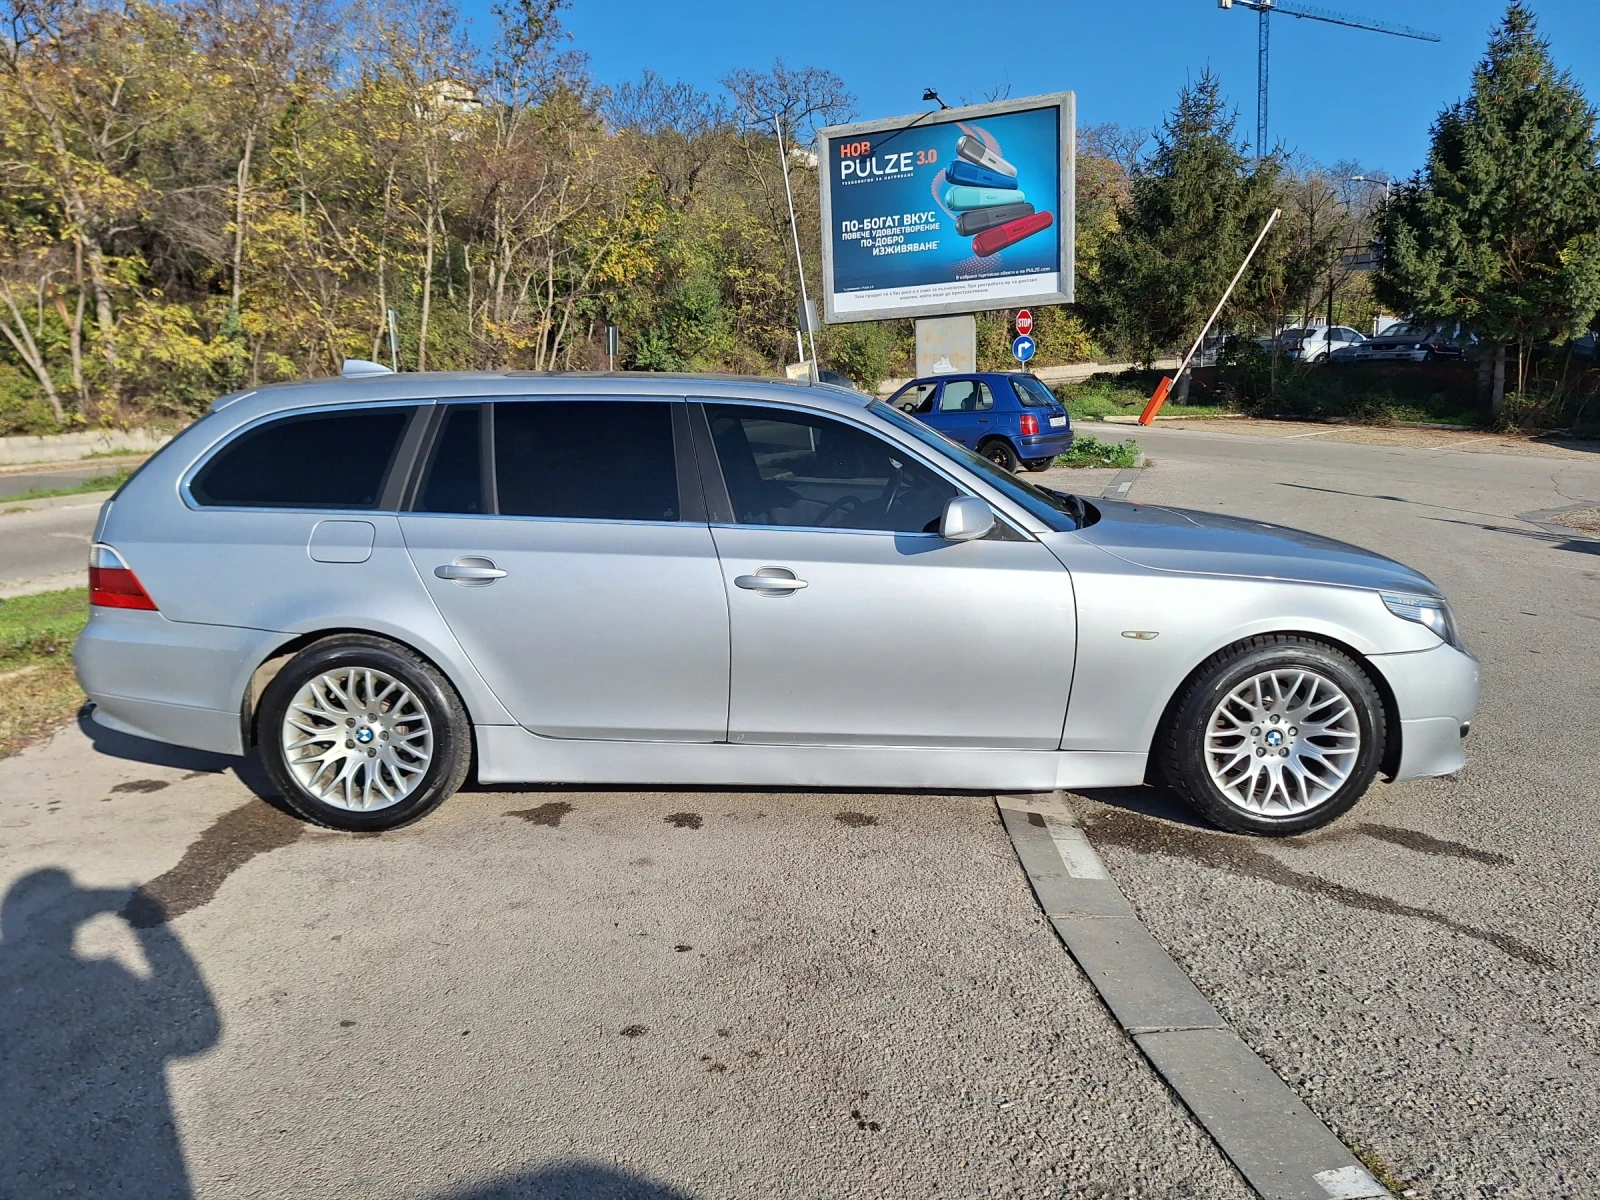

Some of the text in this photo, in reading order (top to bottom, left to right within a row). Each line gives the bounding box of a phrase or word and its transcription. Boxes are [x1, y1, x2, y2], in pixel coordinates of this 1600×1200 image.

[840, 141, 871, 159] НОВ
[841, 149, 938, 180] PULZE 3.0
[842, 211, 936, 233] ПО-БОГАТ ВКУС
[842, 222, 941, 241] ПОВЕЧЕ УДОВЛЕТВОРЕНИЕ
[861, 235, 905, 248] ПО-ДОБРО
[1018, 318, 1031, 328] STOP
